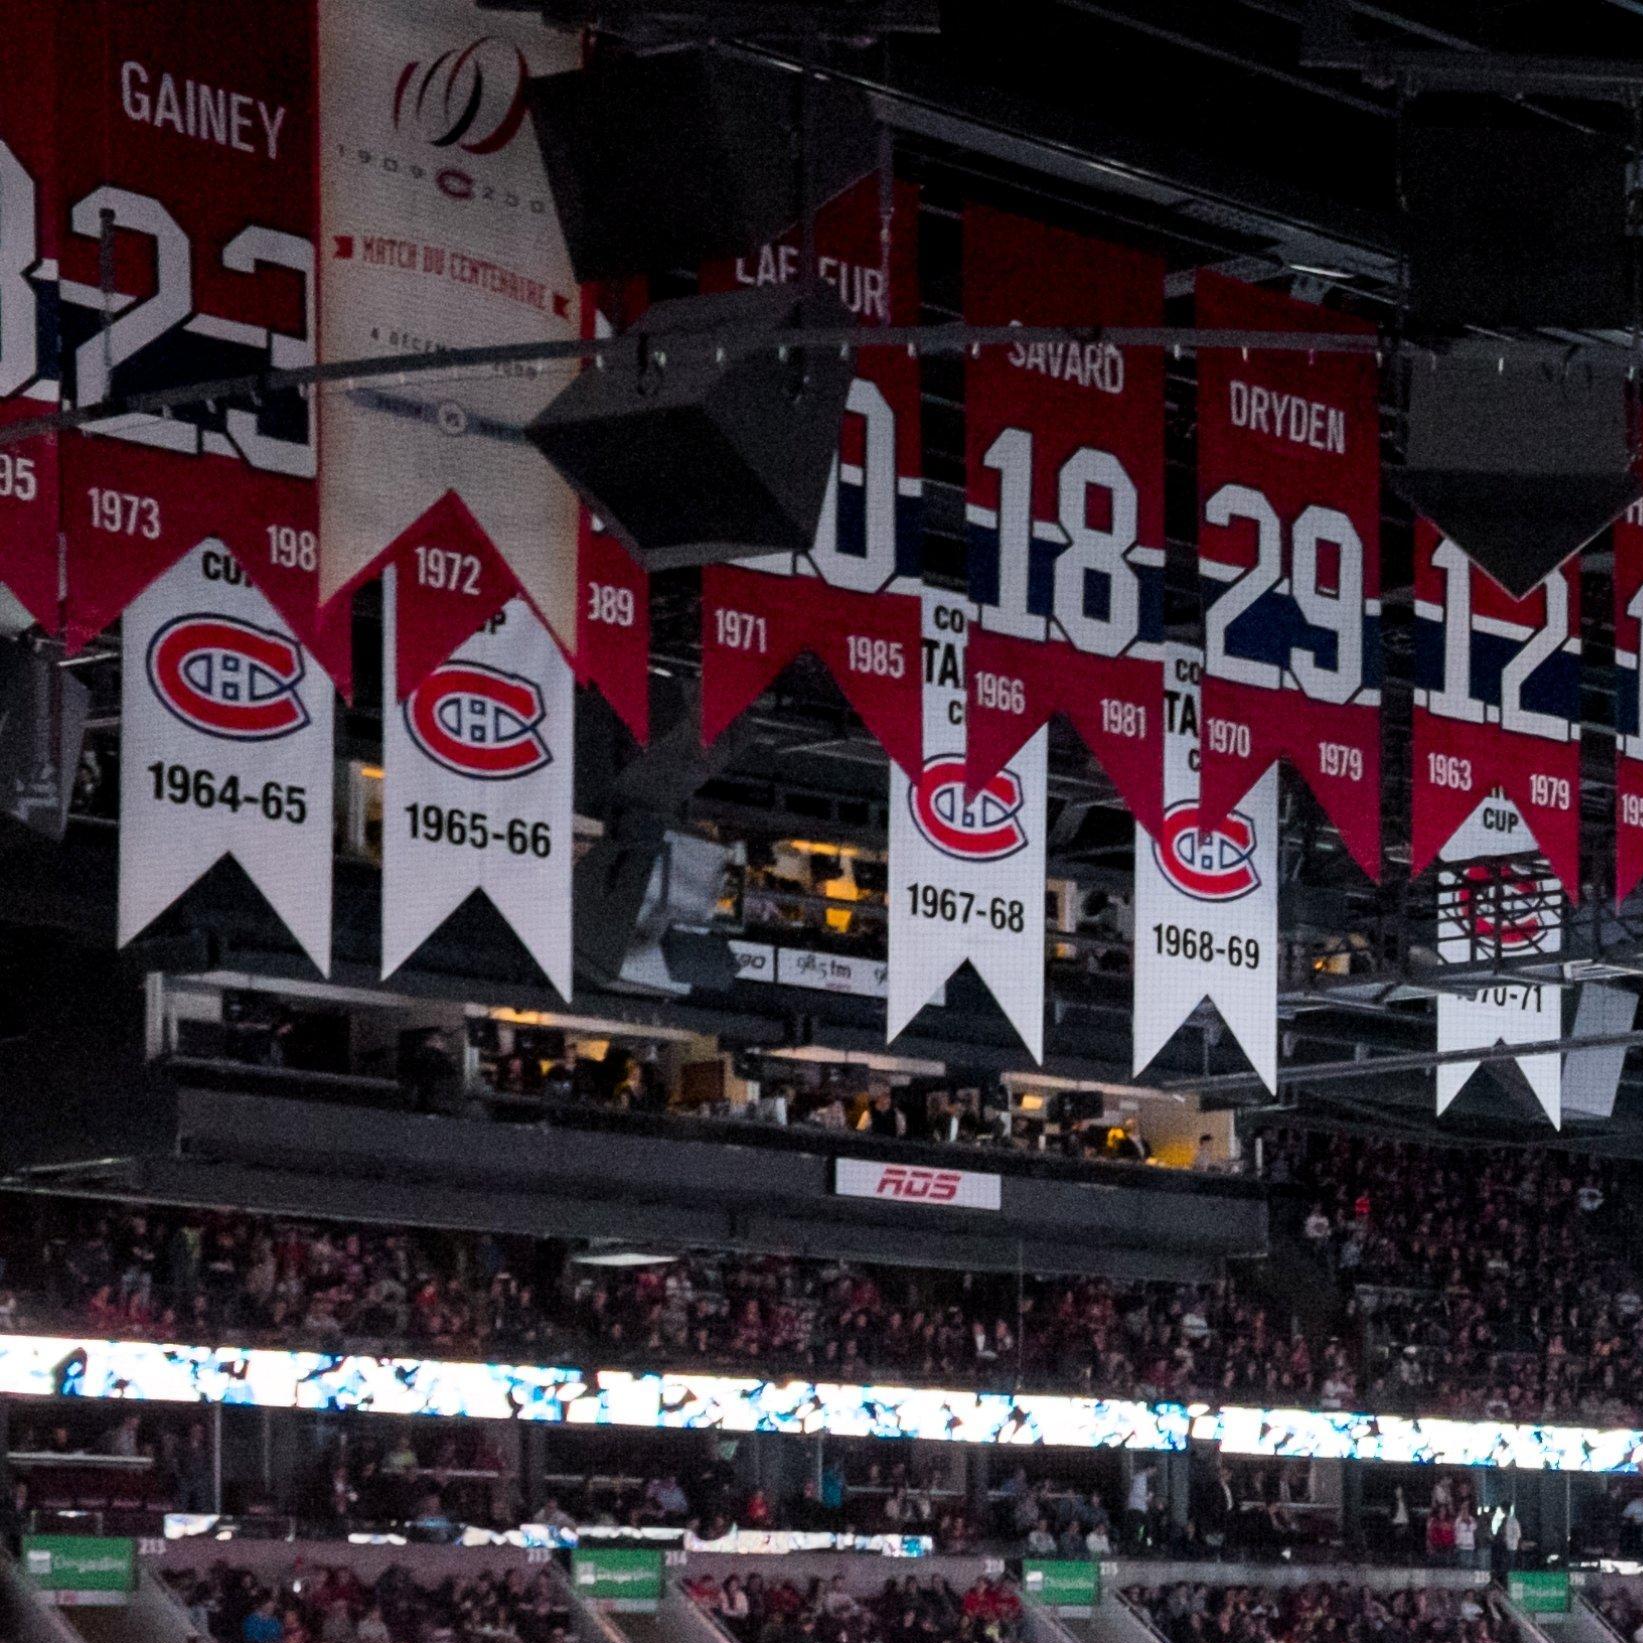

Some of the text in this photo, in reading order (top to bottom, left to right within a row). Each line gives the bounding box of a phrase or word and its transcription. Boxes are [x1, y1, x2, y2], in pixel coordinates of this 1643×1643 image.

[120, 60, 287, 160] GAINEY
[72, 185, 318, 479] 23
[1008, 340, 1124, 394] SAVARD
[1229, 380, 1347, 454] DRYDEN
[87, 488, 161, 538] 1973
[265, 523, 318, 572] 198
[982, 427, 1140, 659] 18
[415, 546, 481, 596] 1972
[1205, 483, 1363, 704] 29
[714, 608, 767, 654] 1971
[1427, 540, 1570, 742] 12
[846, 635, 905, 679] 1985
[975, 671, 1026, 715] 1966
[1100, 698, 1148, 739] 1981
[1207, 719, 1250, 758] 1970
[1319, 742, 1363, 780] 1979
[1428, 753, 1473, 791] 1963
[147, 761, 308, 826] 1964-65
[1529, 773, 1571, 810] 1979
[403, 803, 552, 859] 1965-66
[1482, 807, 1519, 834] CUP
[906, 883, 1025, 932] 1967-68
[1152, 923, 1260, 969] 1968-69
[877, 1168, 962, 1200] RDS
